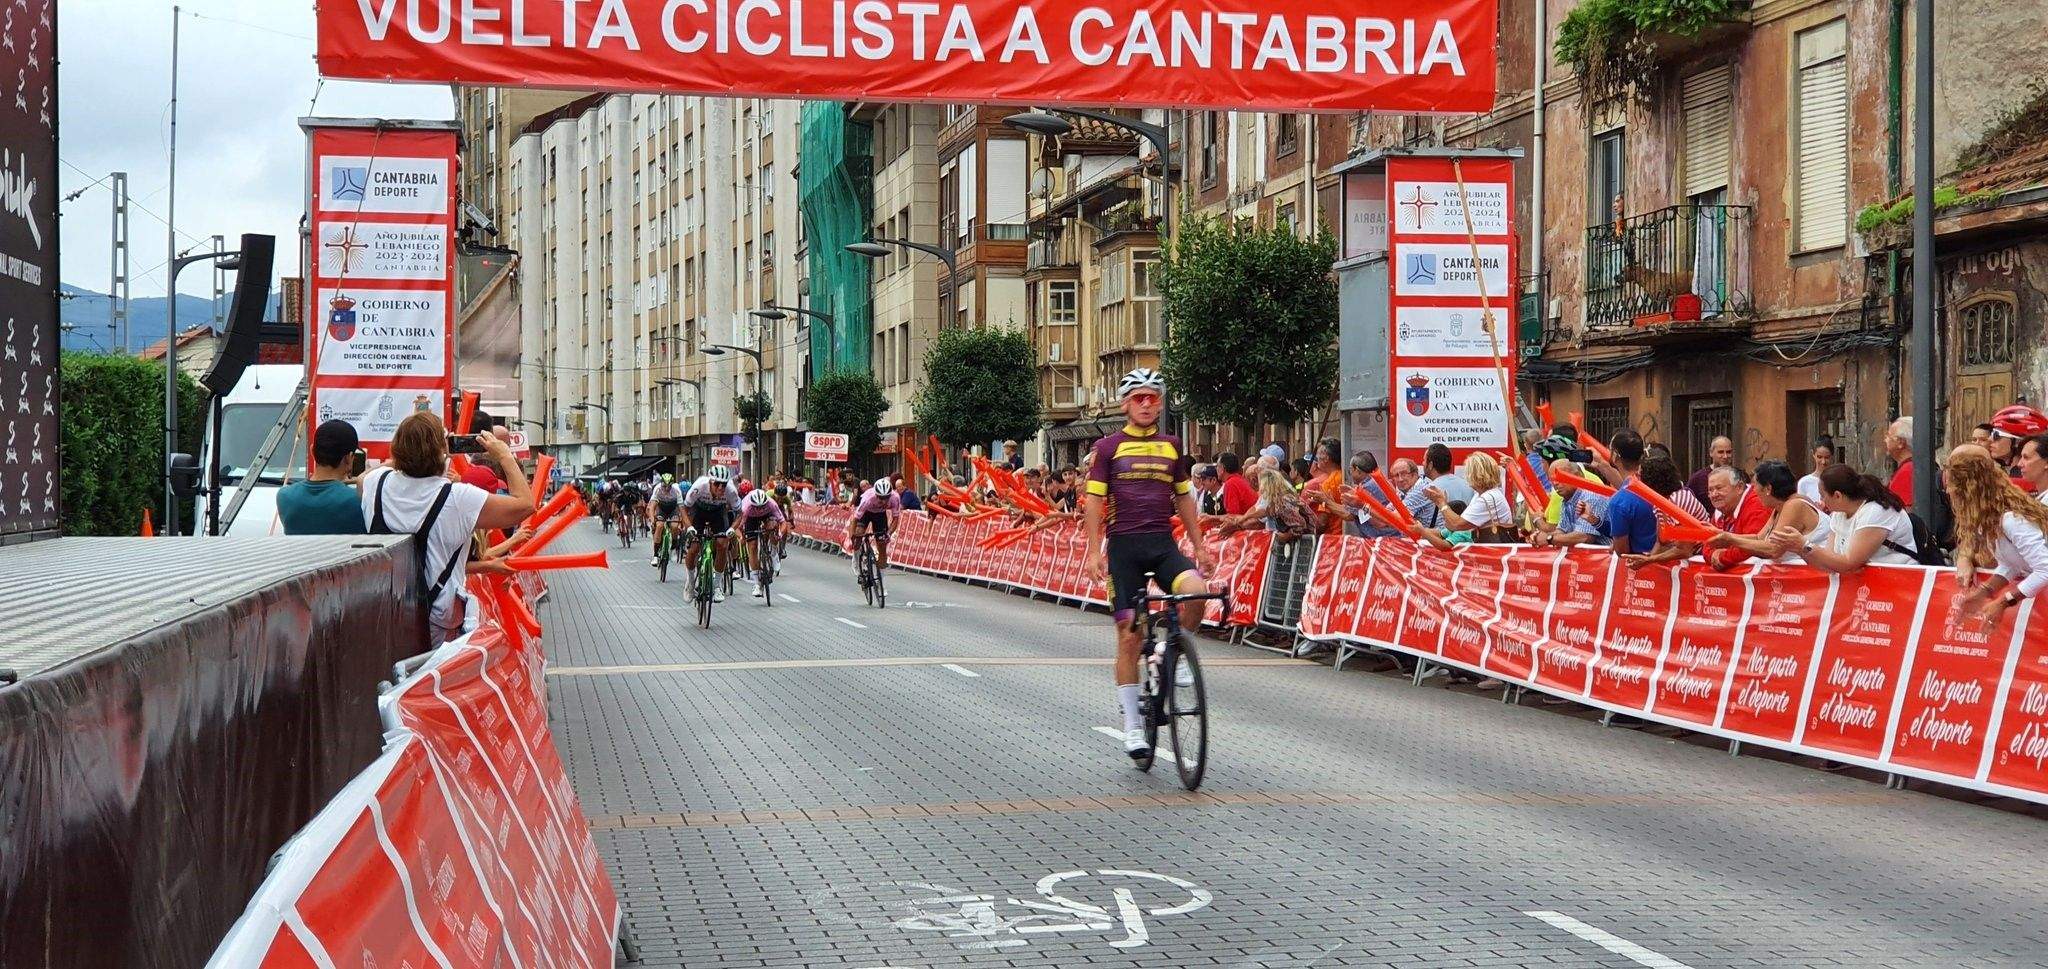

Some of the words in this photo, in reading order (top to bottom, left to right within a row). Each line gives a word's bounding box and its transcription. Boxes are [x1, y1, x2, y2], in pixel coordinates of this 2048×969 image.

[358, 0, 641, 51] VUELTA
[661, 0, 984, 62] CICLISTA
[1000, 4, 1050, 65] A
[1069, 8, 1466, 76] CANTABRIA
[374, 171, 439, 185] CANTABRIA
[374, 187, 419, 198] DEPORTE
[1443, 199, 1501, 208] LEBNIEGO
[375, 241, 440, 251] LEBANIEGO
[374, 264, 440, 272] CANTABRIA
[1443, 271, 1478, 281] DEPORT
[361, 300, 431, 311] GOBIERNO
[361, 313, 380, 323] DE
[361, 326, 436, 338] CANTABRIA
[349, 343, 422, 351] VICEPRESIDENCIA
[343, 352, 388, 360] DIRECCIÓN
[1434, 377, 1495, 387] GOBIERNO
[1434, 390, 1450, 399] DE
[1435, 402, 1500, 412] CANTABRIA
[1419, 425, 1459, 434] DIRECCIÓN
[813, 436, 841, 448] aspro
[716, 448, 734, 458] aspro
[828, 452, 836, 460] M
[1865, 601, 1893, 613] GOBIERNO
[1860, 621, 1891, 633] CANTABRIA
[1954, 630, 1989, 644] CANTABRIA
[1676, 637, 1695, 663] Nos
[1690, 644, 1723, 672] gusta
[1746, 647, 1769, 674] Nos
[1762, 654, 1798, 684] gusta
[1828, 657, 1852, 687] Nos
[1846, 666, 1885, 698] gusta
[1666, 667, 1684, 692] el
[1675, 667, 1712, 704] deporte
[1919, 669, 1947, 701] Nos
[1939, 678, 1983, 712] gusta
[1738, 679, 1755, 707] el
[1748, 680, 1790, 718] deporte
[1819, 692, 1838, 723] el
[1832, 693, 1877, 734] deporte
[1910, 707, 1930, 739] el
[1923, 707, 1973, 751] deporte
[2010, 721, 2033, 755] el
